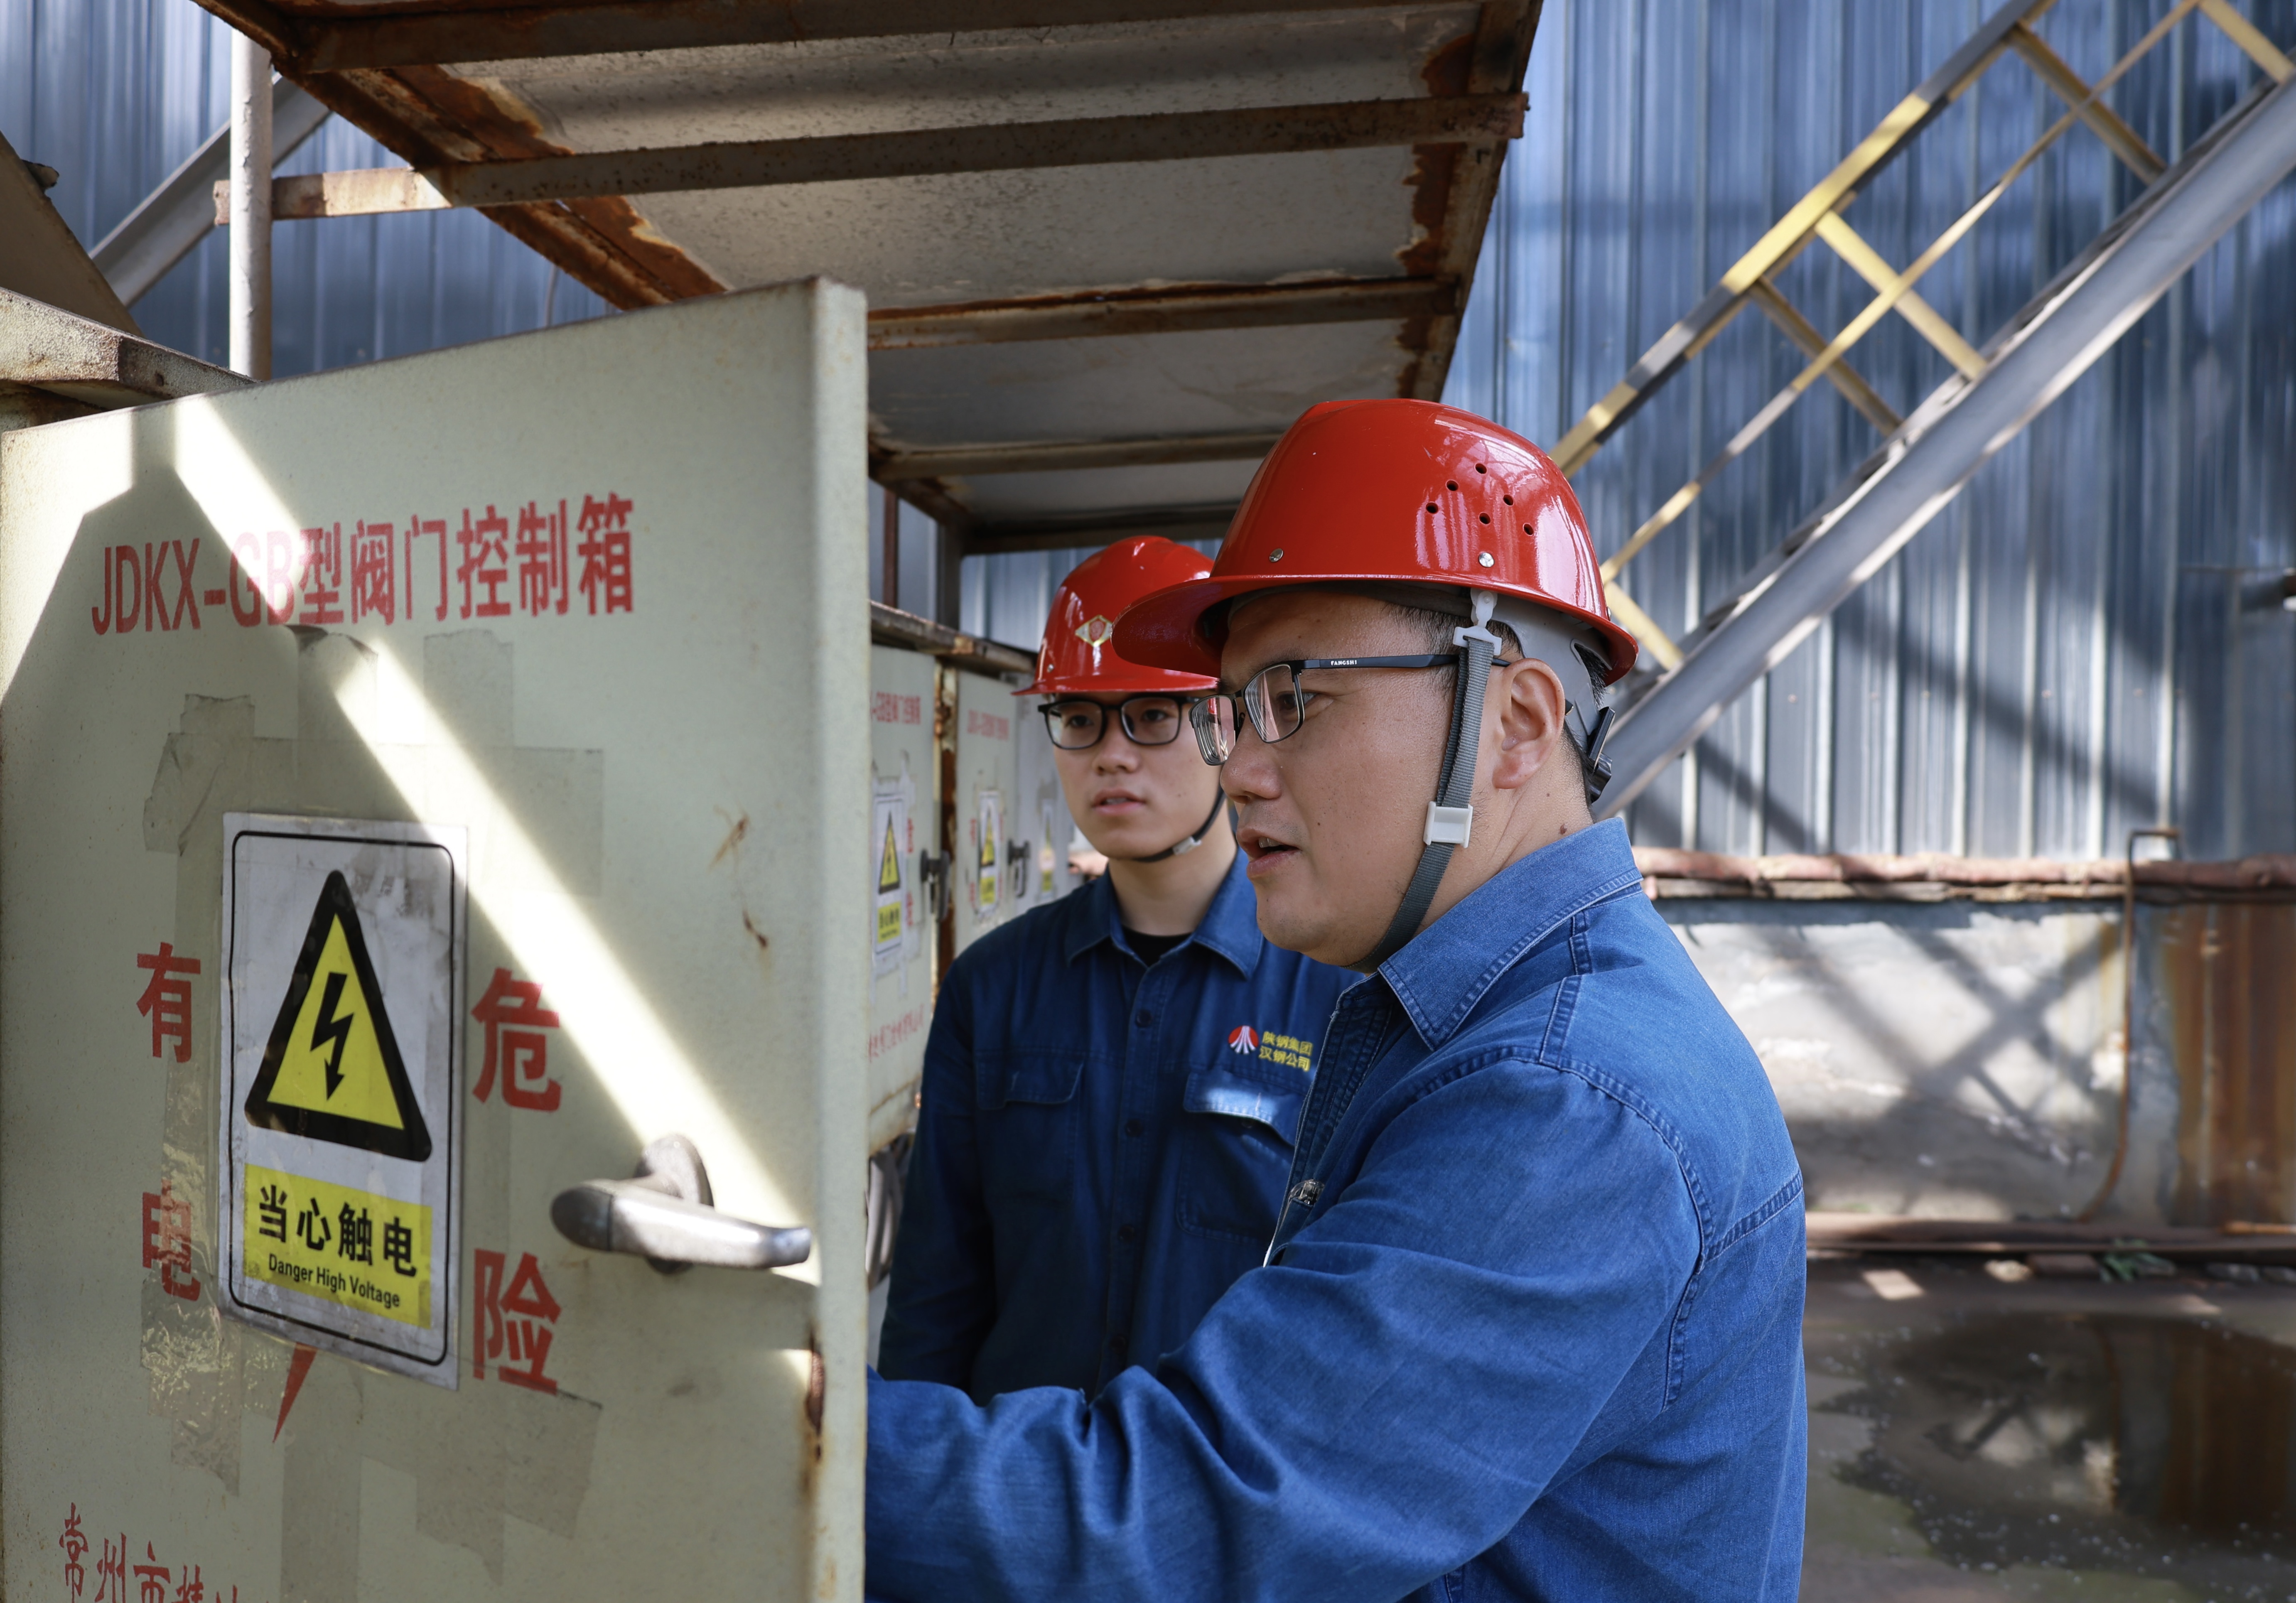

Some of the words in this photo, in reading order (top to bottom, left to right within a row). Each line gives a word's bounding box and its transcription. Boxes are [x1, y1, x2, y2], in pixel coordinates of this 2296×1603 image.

[91, 492, 634, 636] JDKX-GB型阀门控制箱
[1259, 1046, 1310, 1071] 汉钢公司
[259, 1184, 417, 1278] 当心触电
[268, 1253, 313, 1282] Danger
[316, 1266, 346, 1293] High
[349, 1276, 400, 1309] Voltage
